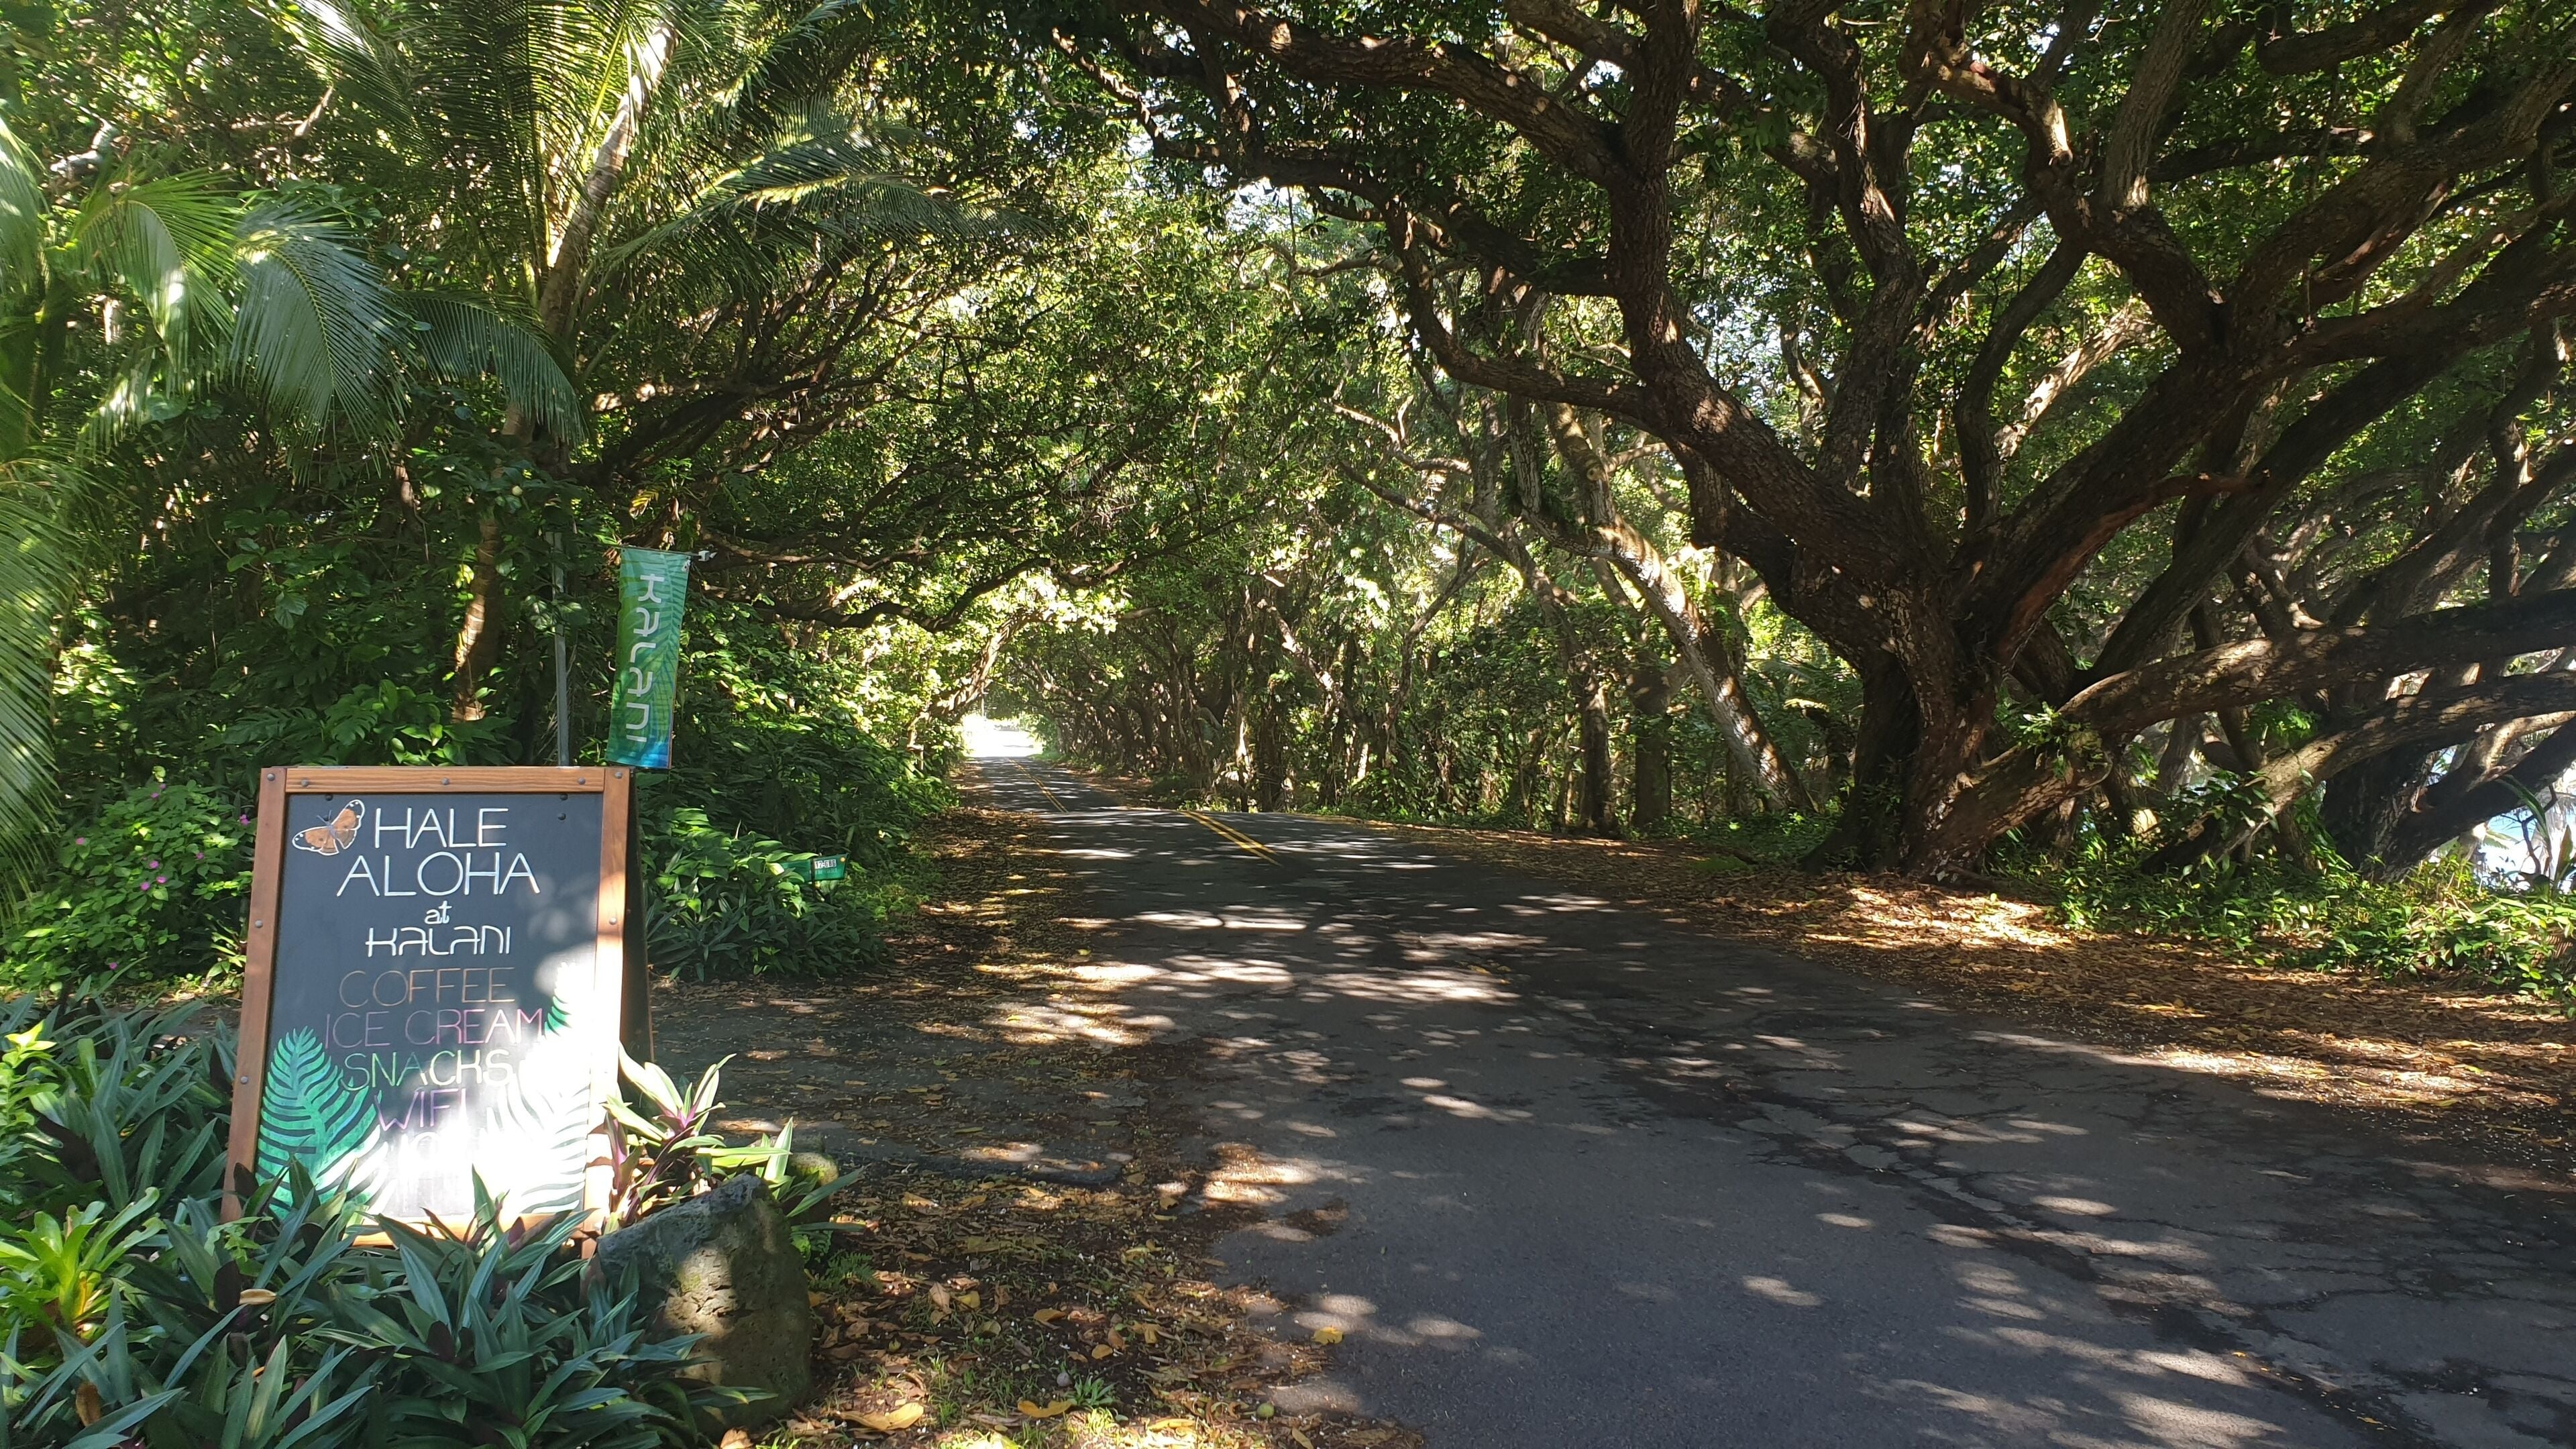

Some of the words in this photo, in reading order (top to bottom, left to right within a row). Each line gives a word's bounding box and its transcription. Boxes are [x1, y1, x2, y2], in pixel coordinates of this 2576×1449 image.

[375, 807, 508, 849] HALE
[337, 851, 541, 897] ALOHA
[424, 900, 452, 924] at
[339, 967, 516, 1007] COFFEE
[325, 1011, 391, 1050] ICE
[405, 1008, 545, 1046] CREAM
[341, 1049, 514, 1091] SNACKS
